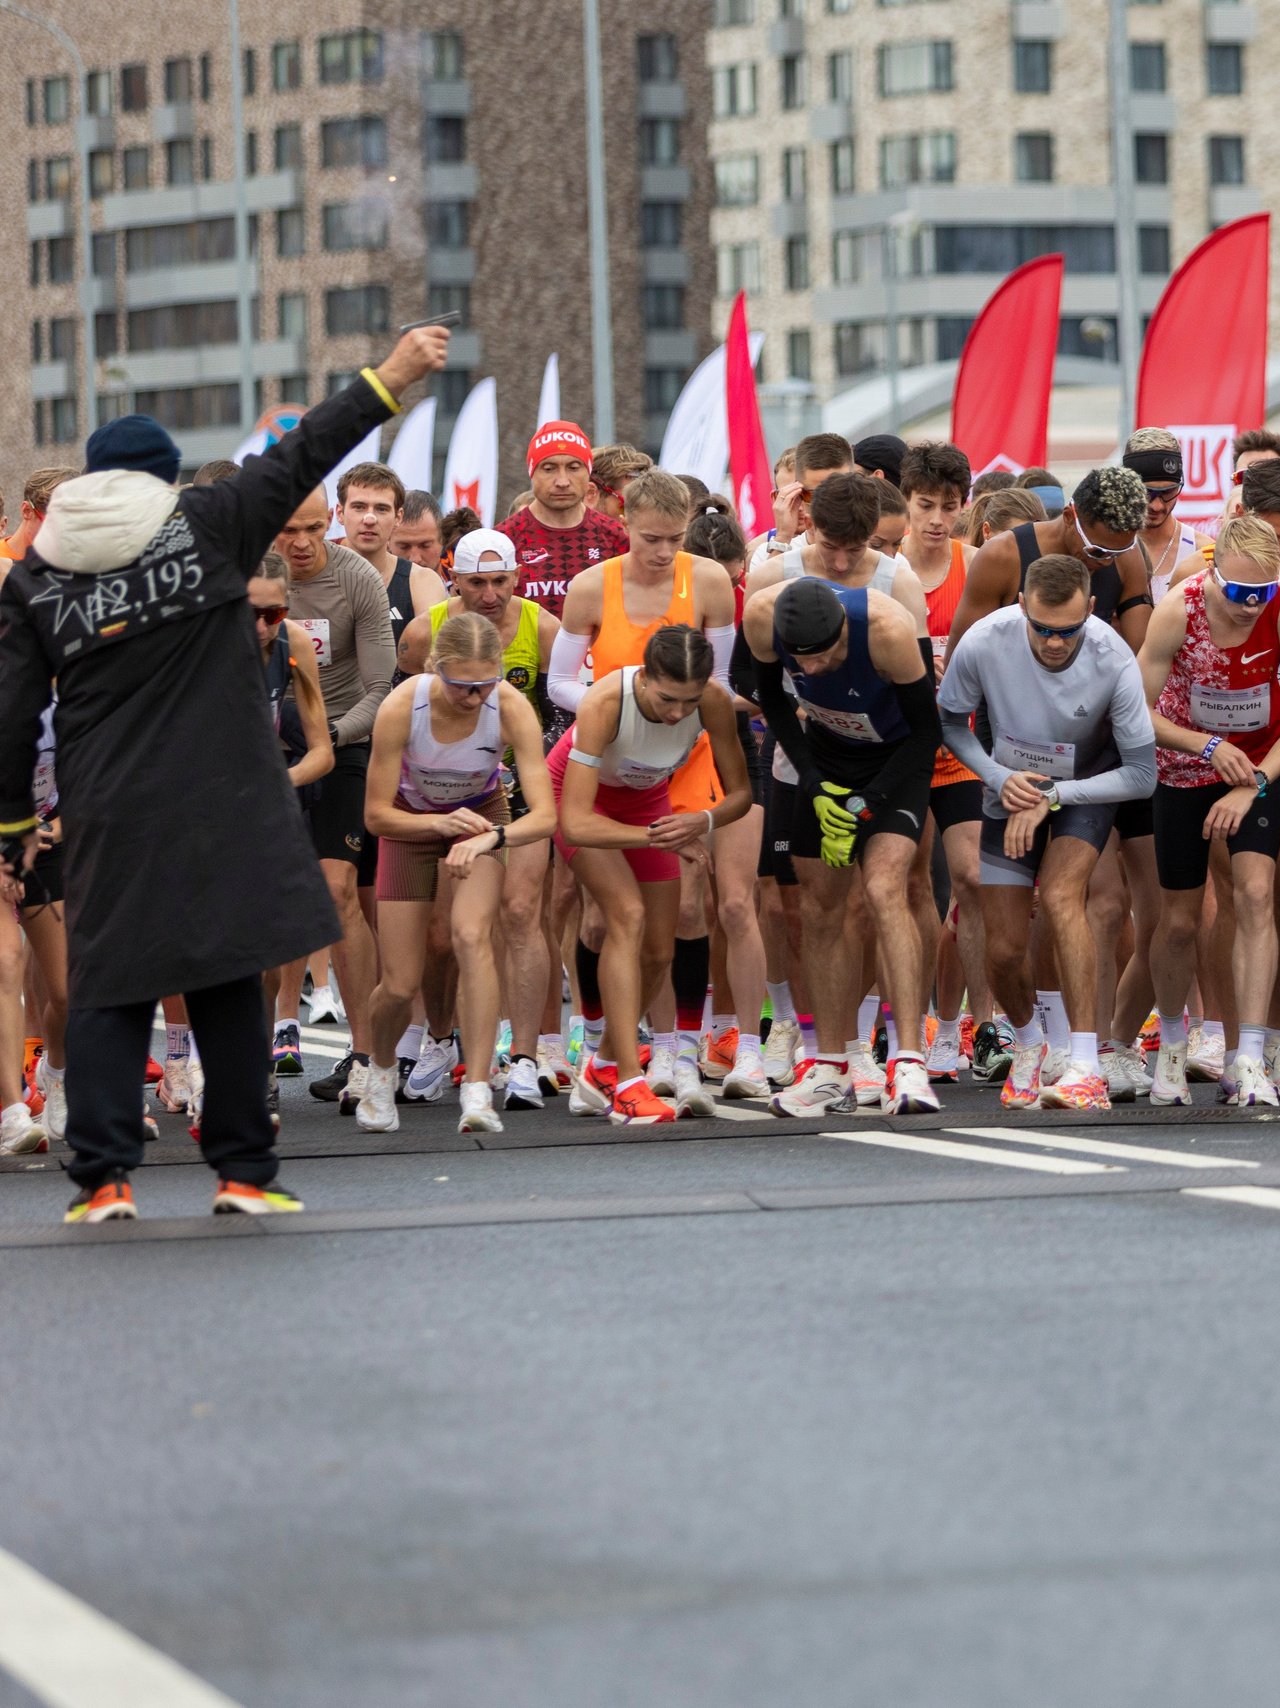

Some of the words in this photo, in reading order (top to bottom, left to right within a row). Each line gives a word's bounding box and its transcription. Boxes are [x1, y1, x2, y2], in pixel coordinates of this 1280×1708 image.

[535, 431, 587, 450] LUKOIL
[524, 580, 572, 598] ЛУК
[1200, 701, 1261, 711] РЫБАЛКИН
[809, 708, 867, 732] 1582
[1013, 749, 1053, 764] ГУЩИН
[1028, 761, 1039, 769] 20
[423, 779, 472, 788] МОКИНА
